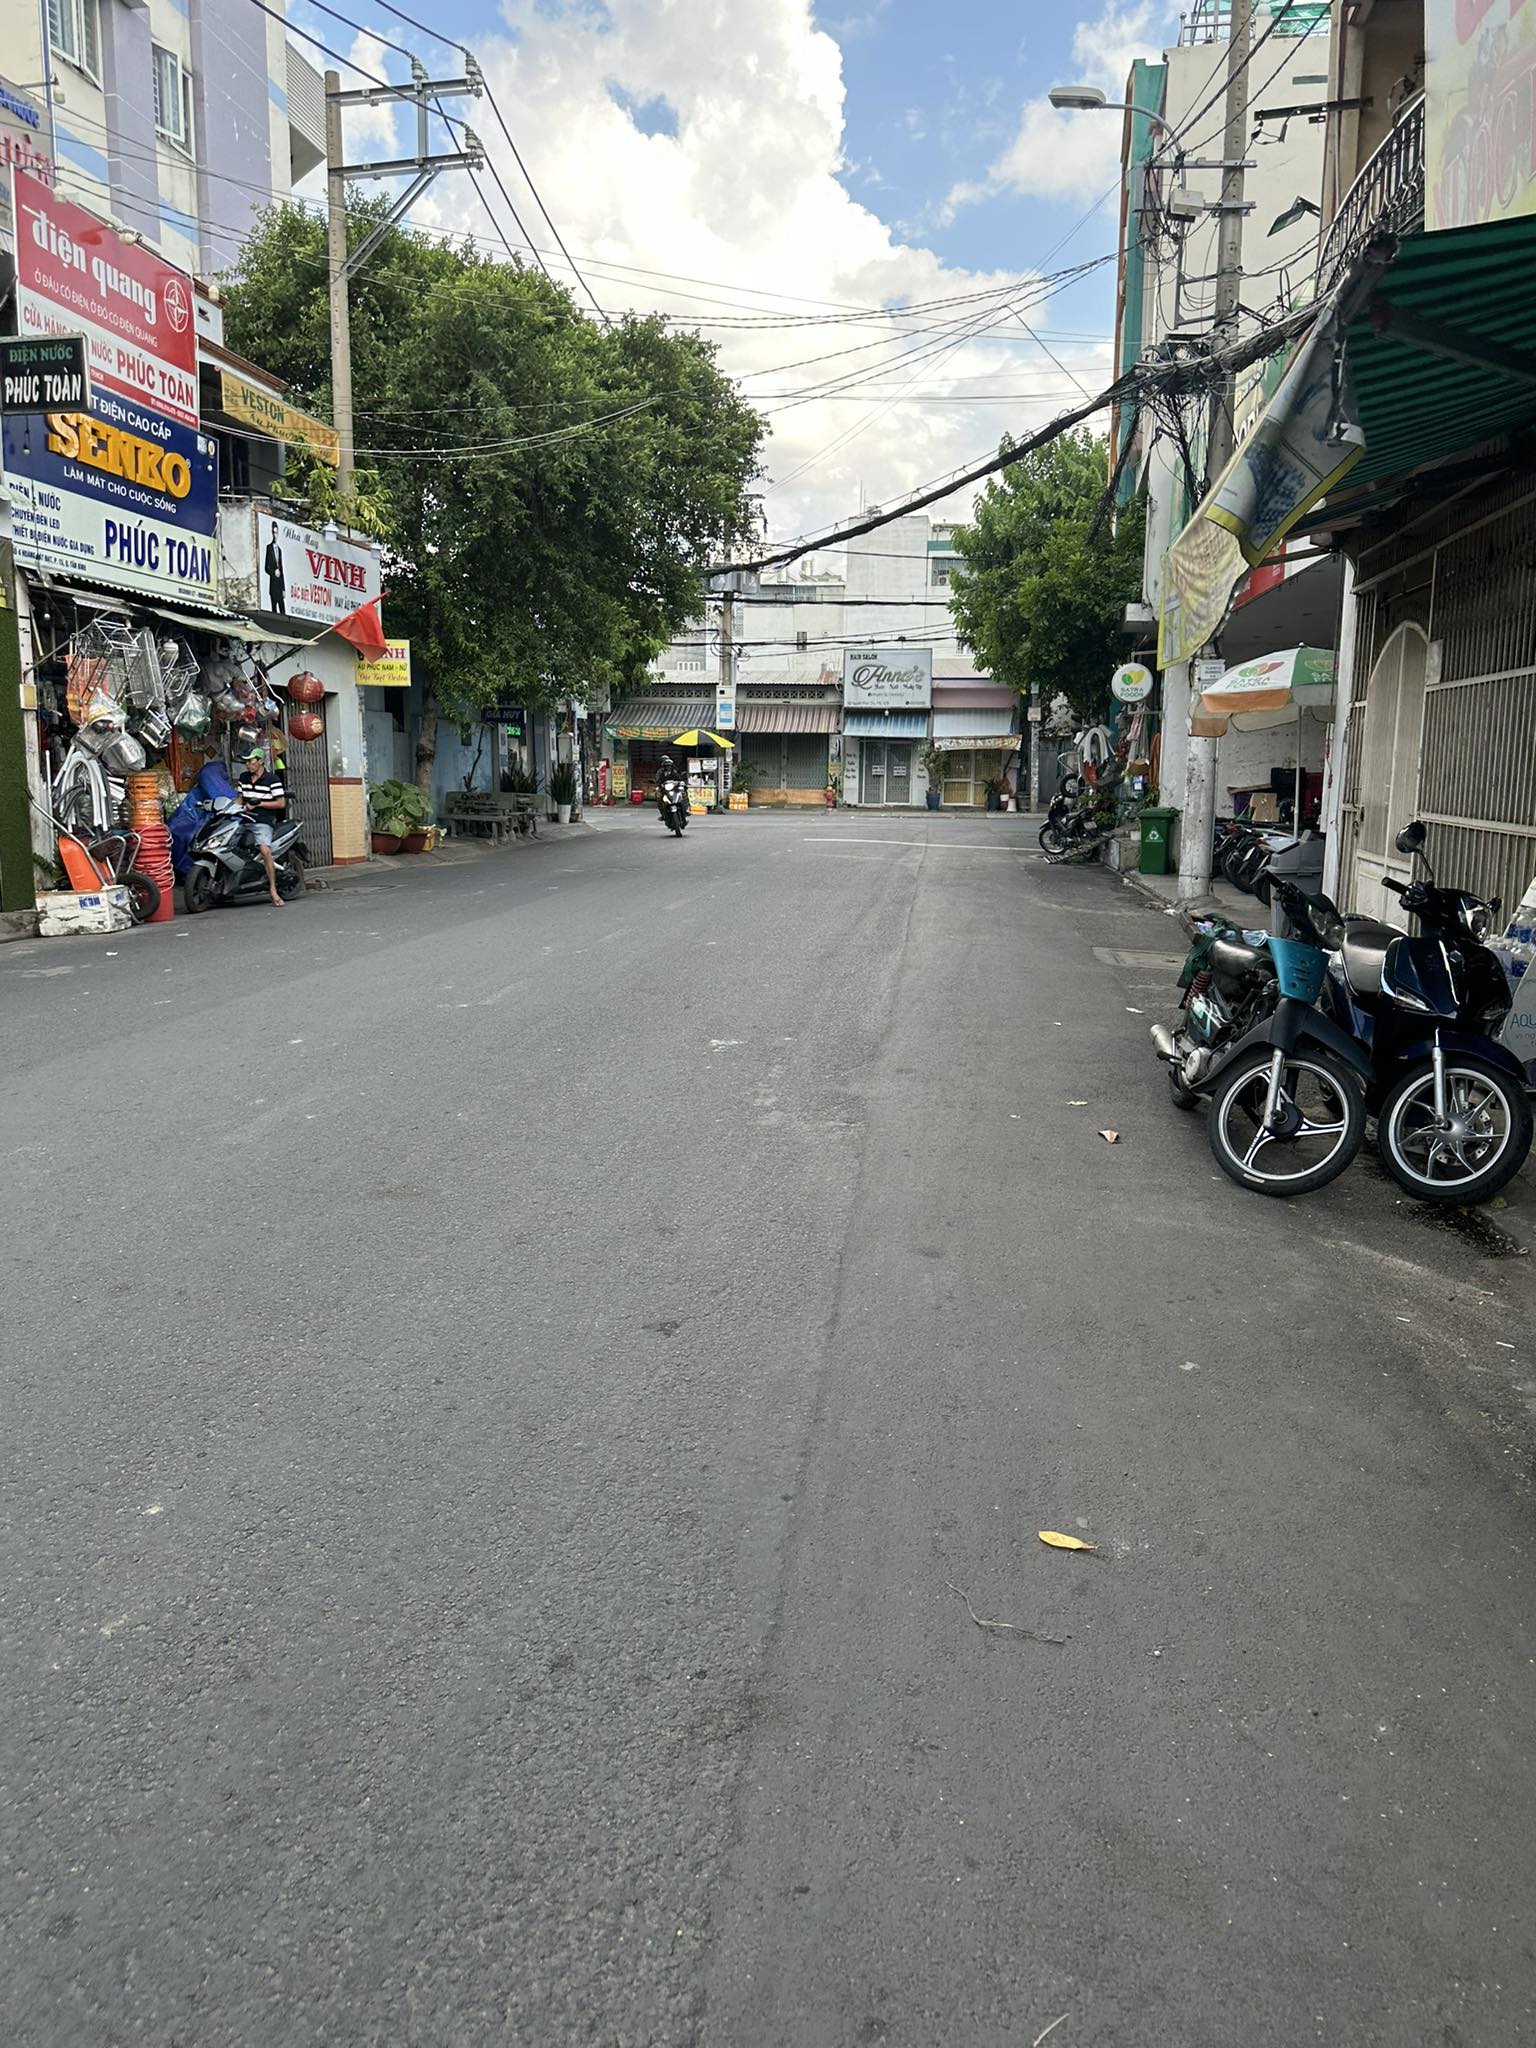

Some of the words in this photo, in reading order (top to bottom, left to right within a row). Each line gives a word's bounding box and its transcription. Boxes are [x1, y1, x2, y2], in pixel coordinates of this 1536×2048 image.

[22, 204, 87, 273] điện
[92, 256, 157, 325] quang
[43, 274, 59, 294] ĐÂU
[60, 283, 71, 300] CÓ
[135, 326, 158, 348] QUANG
[9, 345, 38, 365] ĐIỆN
[40, 343, 73, 361] NƯỚC
[23, 302, 43, 330] CỬA
[91, 339, 113, 364] NƯỚC
[117, 348, 156, 390] PHÚC
[159, 370, 194, 409] TOÀN
[5, 368, 40, 404] PHÚC
[43, 366, 82, 403] TOÀN
[100, 399, 126, 421] ĐIỆN
[128, 411, 150, 432] CAO
[151, 420, 172, 440] CẤP
[241, 386, 285, 425] VESTON
[48, 412, 192, 498] SENKO
[38, 491, 61, 511] NƯỚC
[107, 481, 127, 496] CHO
[130, 489, 153, 506] CUỘC
[154, 496, 177, 514] SỐNG
[49, 517, 60, 530] LED
[105, 518, 160, 570] PHÚC
[165, 536, 211, 583] TOÀN
[306, 549, 366, 593] VINH
[310, 583, 332, 607] VESTON
